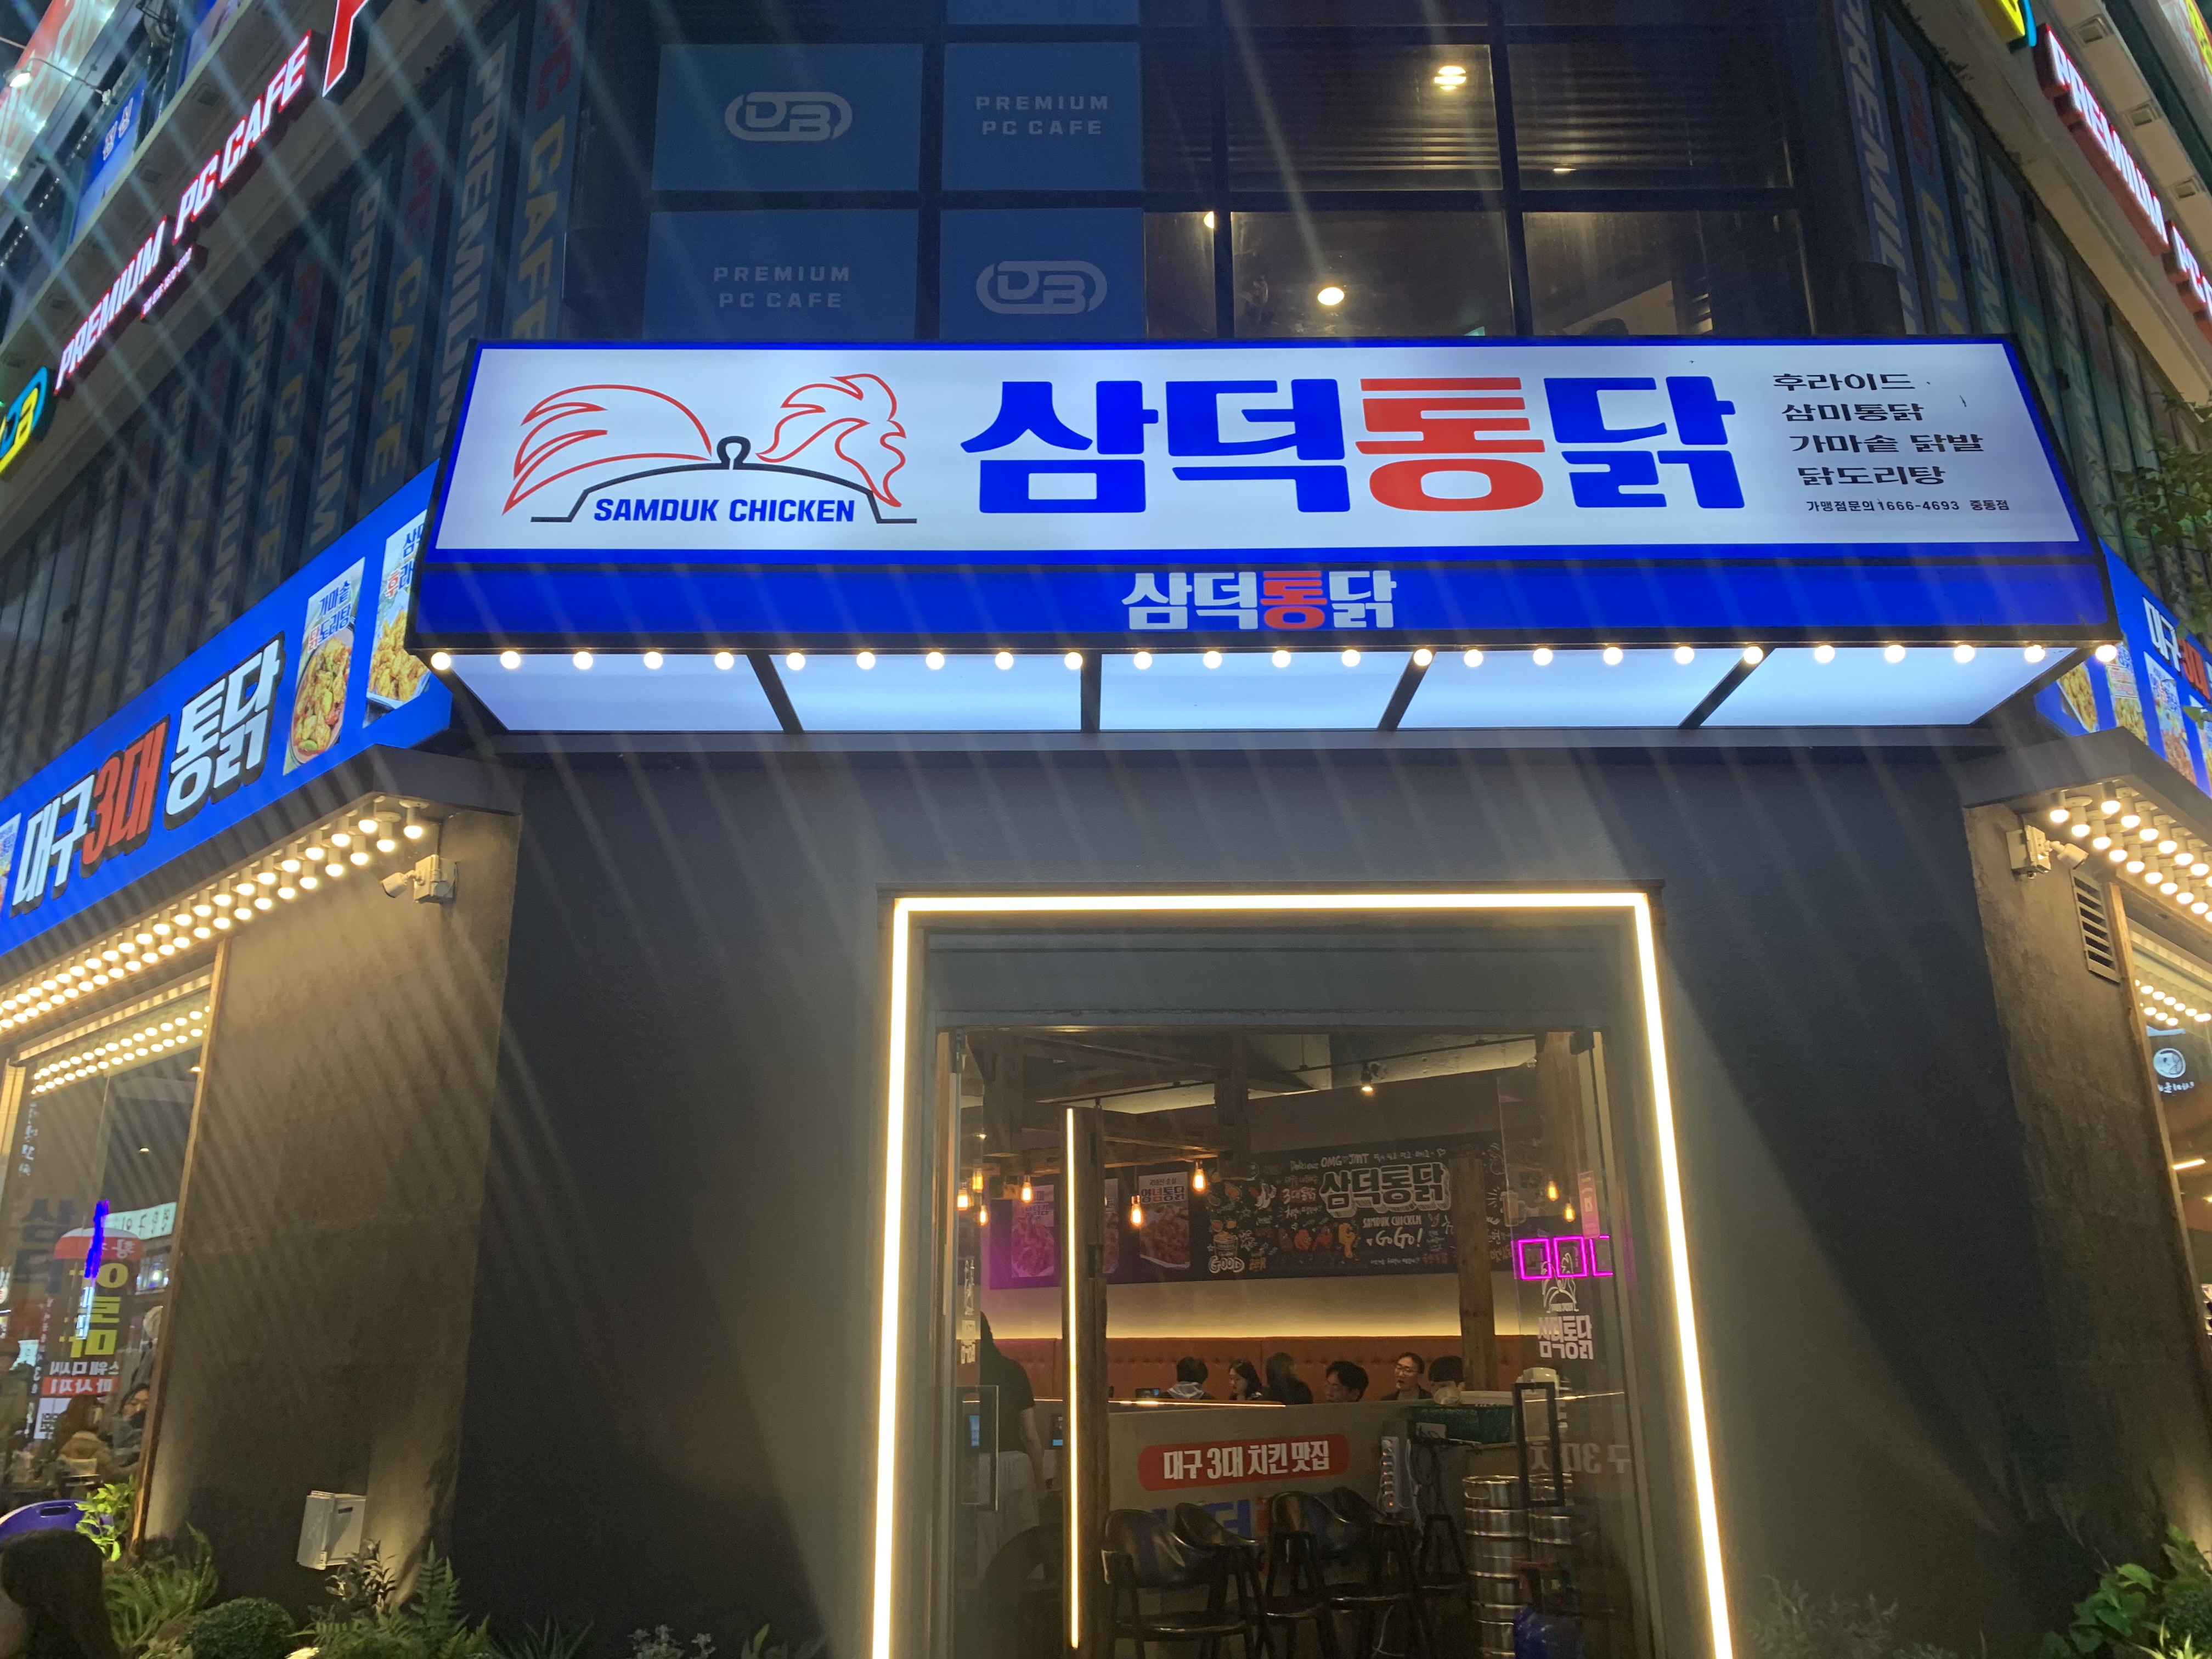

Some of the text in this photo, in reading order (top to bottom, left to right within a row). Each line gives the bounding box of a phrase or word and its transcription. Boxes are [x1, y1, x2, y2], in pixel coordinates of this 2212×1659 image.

[976, 95, 1108, 111] PREMIUM
[982, 121, 1102, 136] PC CAFE
[54, 217, 167, 395] PREMIUM
[172, 151, 219, 244] PC
[219, 30, 311, 188] CAFE
[713, 267, 850, 283] PREMIUM
[719, 293, 841, 308] PC CAFE
[1773, 373, 1915, 391] 후라이드
[1781, 403, 1924, 422] 삼미통닭
[961, 376, 1746, 514] 삼덕통닭
[1790, 433, 1984, 453] 가마솥 닭발
[1798, 466, 1946, 486] 닭도리탕
[594, 498, 855, 522] SAMDUK CHICKEN
[1970, 499, 2010, 511] 중동점
[319, 580, 352, 618] 가마솥
[1121, 569, 1397, 630] 삼덕통닭
[308, 603, 352, 653] 닭도리탕
[166, 639, 281, 816] 통닭
[1321, 1162, 1449, 1215] 삼덕통닭
[1208, 1255, 1245, 1273] GOOD
[1163, 1440, 1330, 1480] 대구 3대 치킨 맛집
